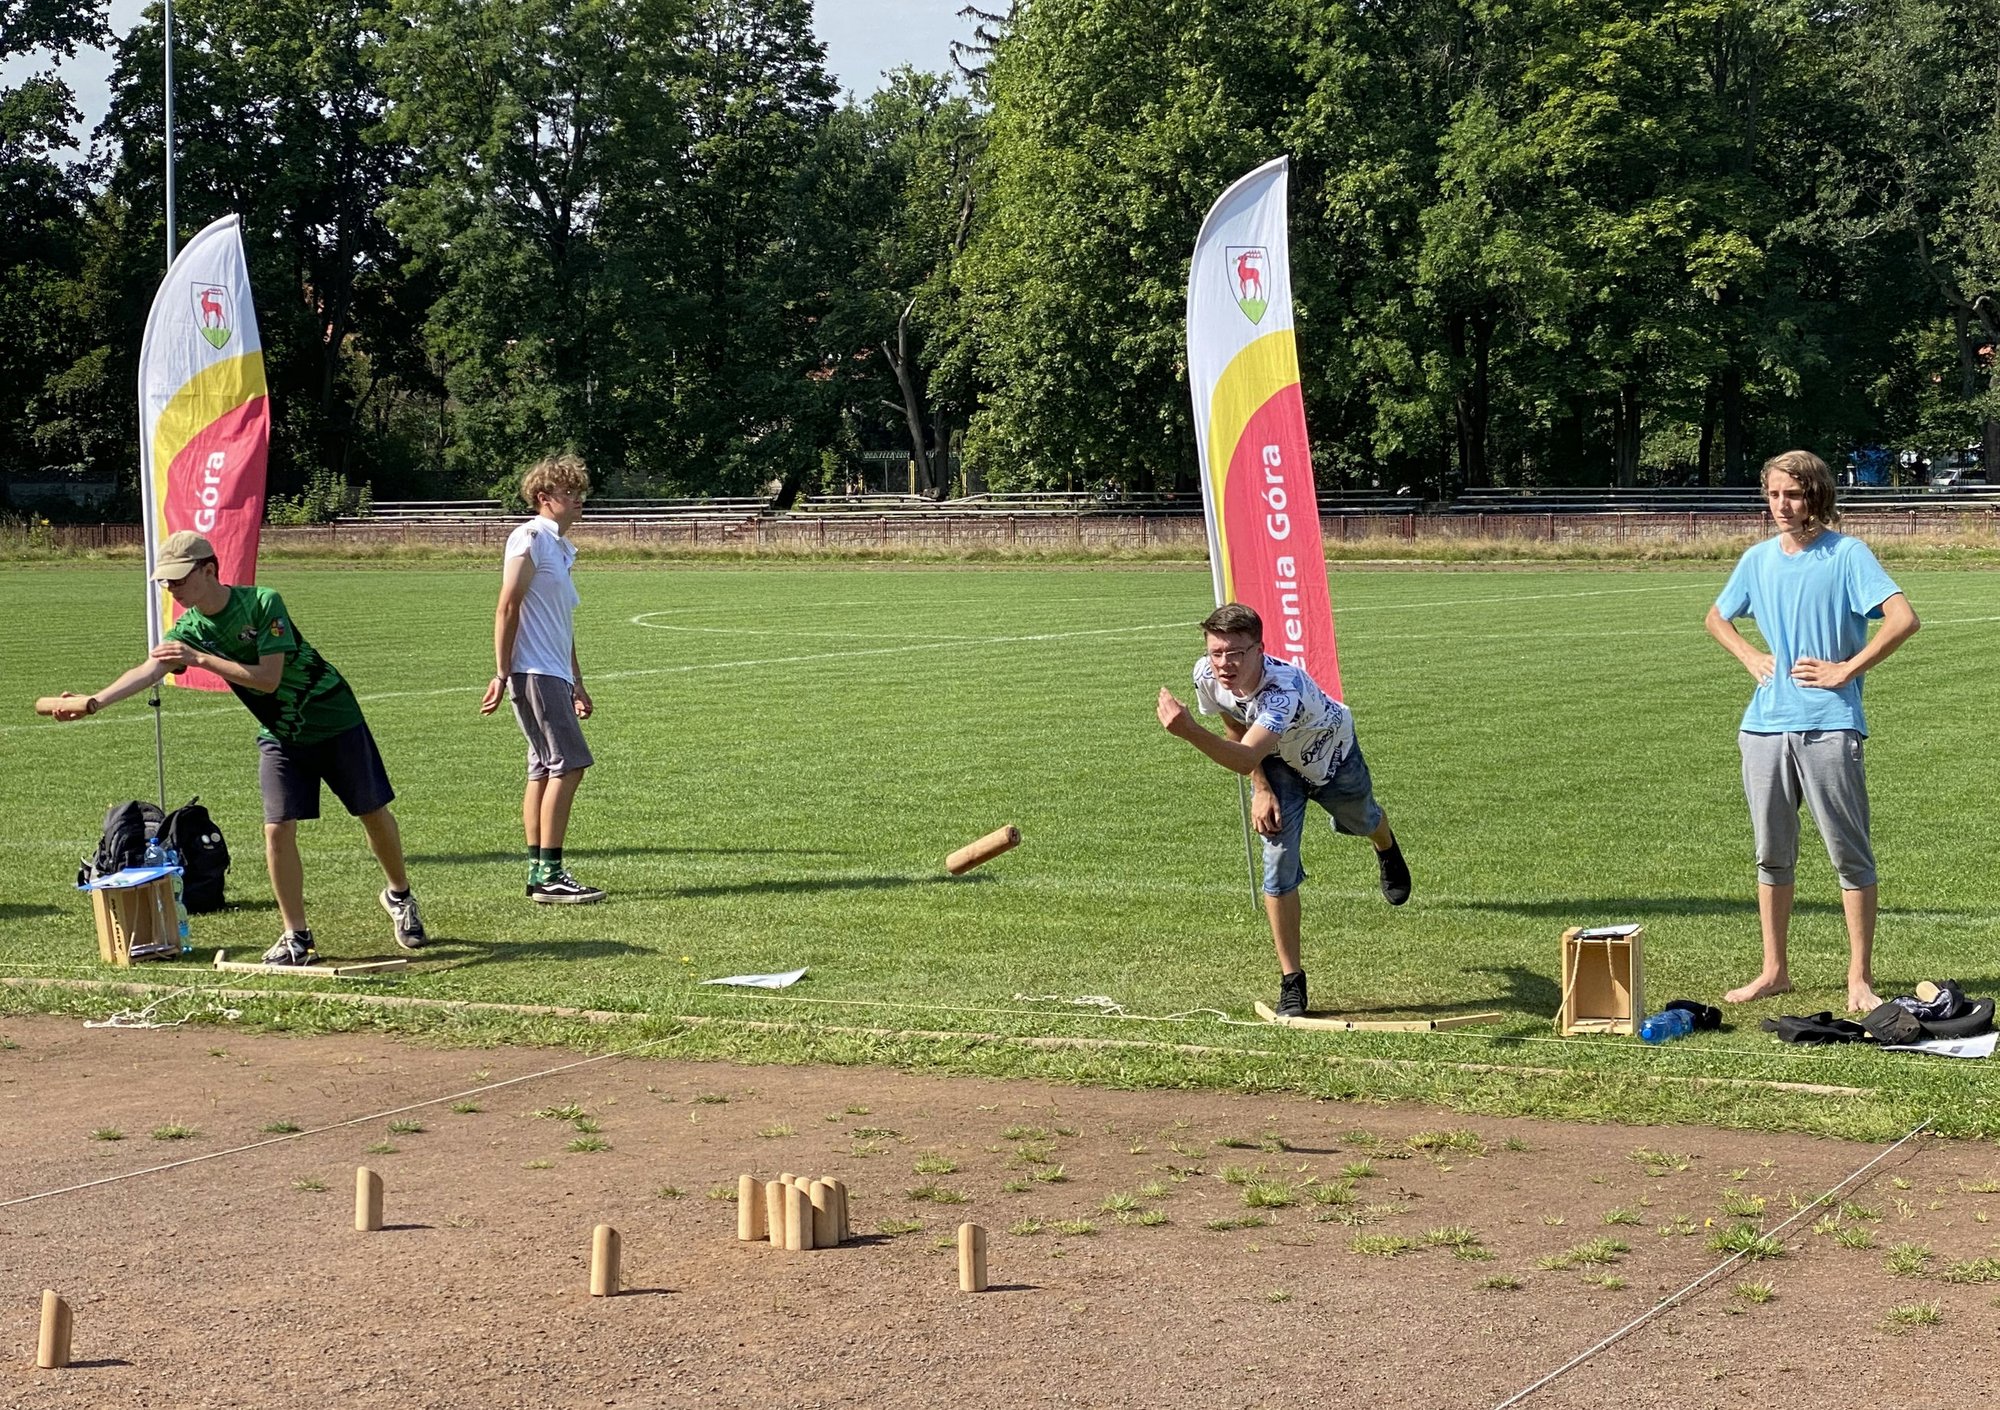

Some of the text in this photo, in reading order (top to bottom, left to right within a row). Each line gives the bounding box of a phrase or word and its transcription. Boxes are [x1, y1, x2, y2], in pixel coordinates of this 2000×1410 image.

[194, 451, 226, 533] Góra
[1261, 444, 1292, 541] Góra
[1275, 556, 1307, 671] elenia
